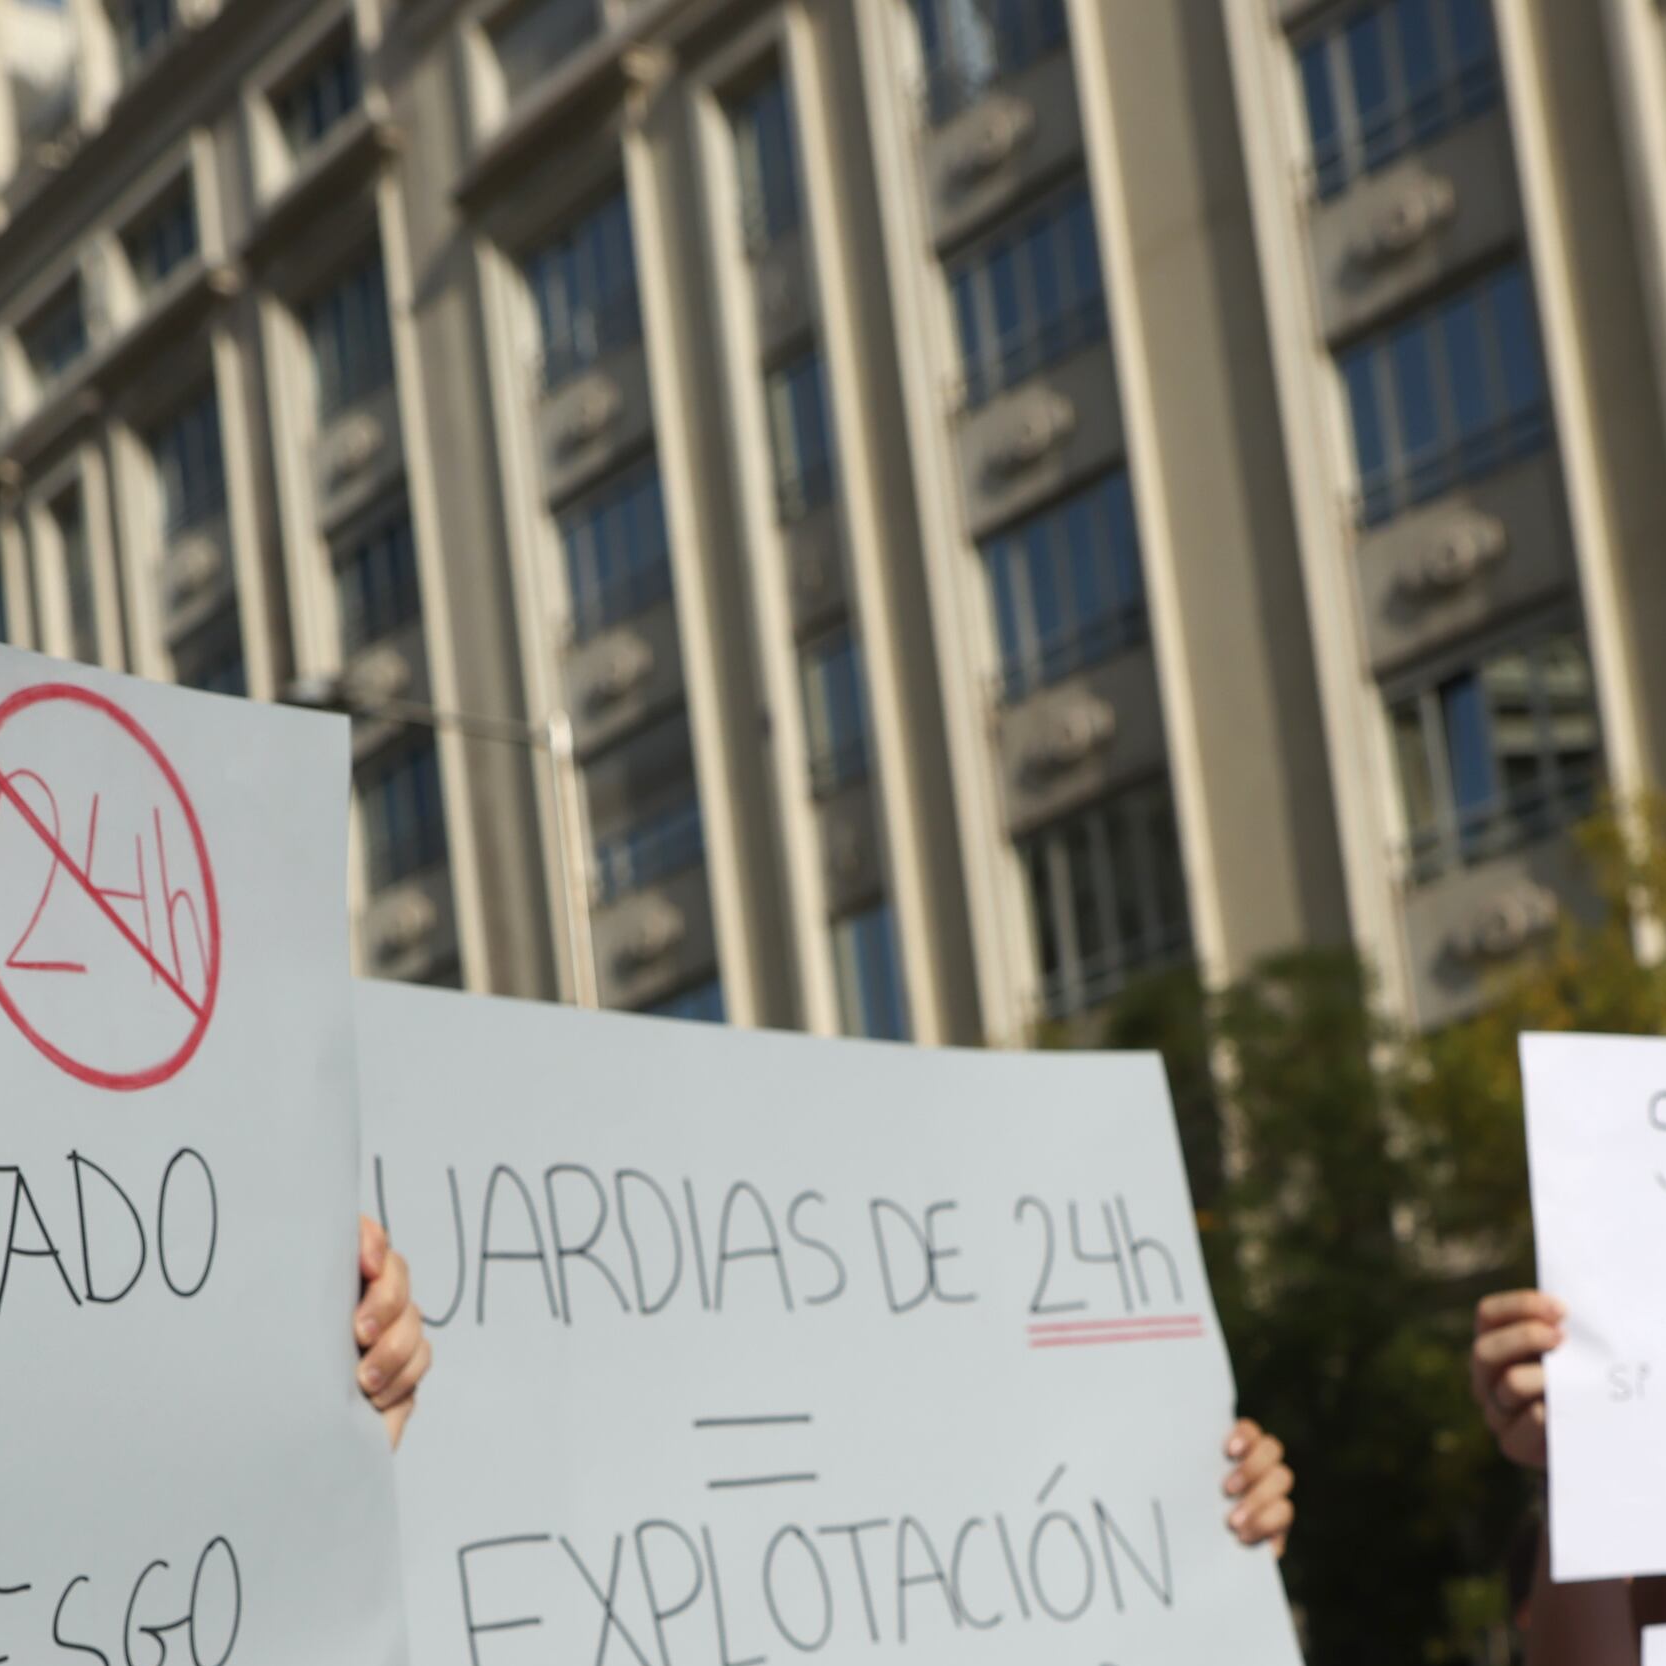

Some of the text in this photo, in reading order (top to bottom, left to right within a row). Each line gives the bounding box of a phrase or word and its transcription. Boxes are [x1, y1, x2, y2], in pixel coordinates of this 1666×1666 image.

[375, 1155, 1184, 1327] UARDIAS DE 24h
